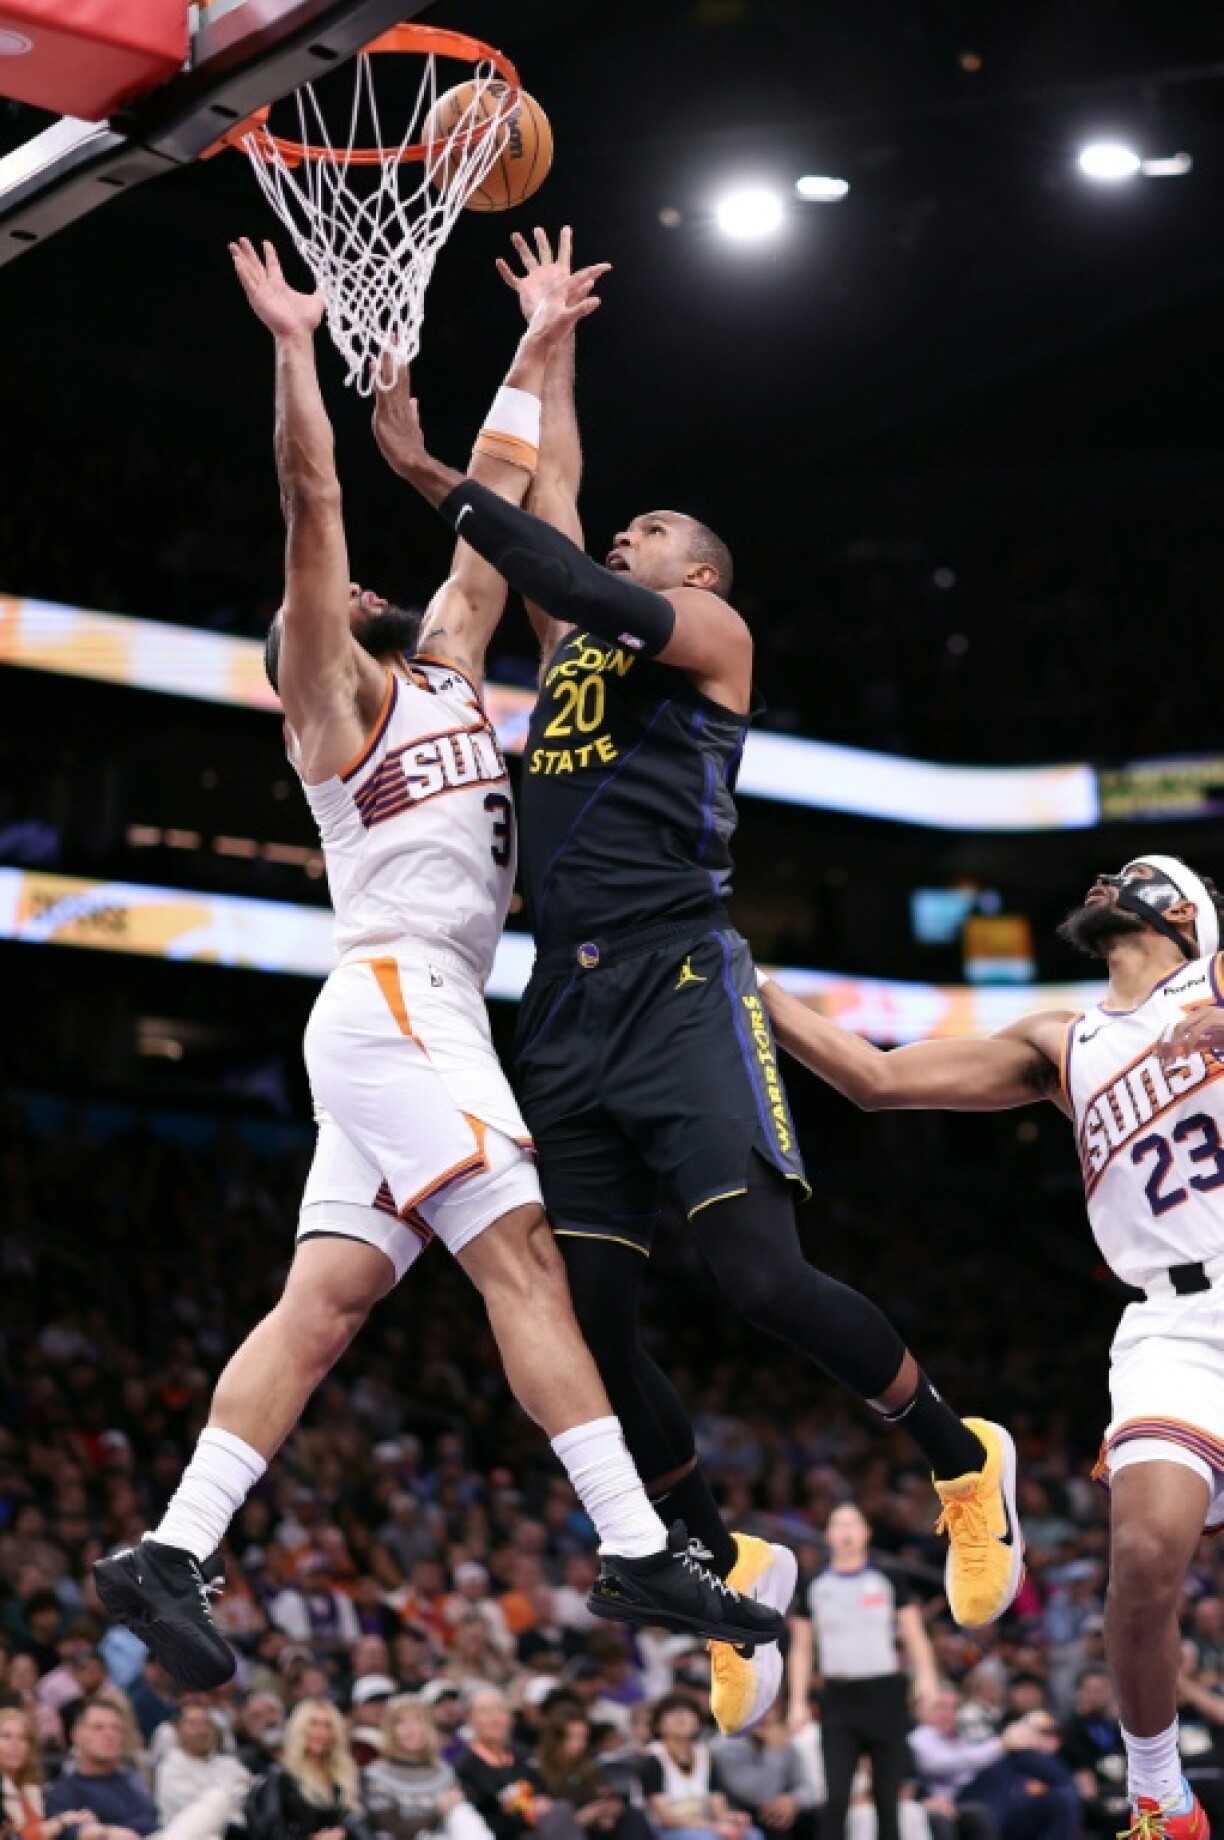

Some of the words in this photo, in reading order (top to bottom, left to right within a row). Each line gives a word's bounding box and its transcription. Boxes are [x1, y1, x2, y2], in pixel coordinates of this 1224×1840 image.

[544, 674, 605, 739] 20
[402, 731, 505, 800] SUN
[529, 733, 619, 775] STATE
[483, 792, 511, 867] 3
[742, 996, 792, 1153] WARRIORS
[1086, 1051, 1207, 1175] SUNS
[1131, 1112, 1224, 1218] 23
